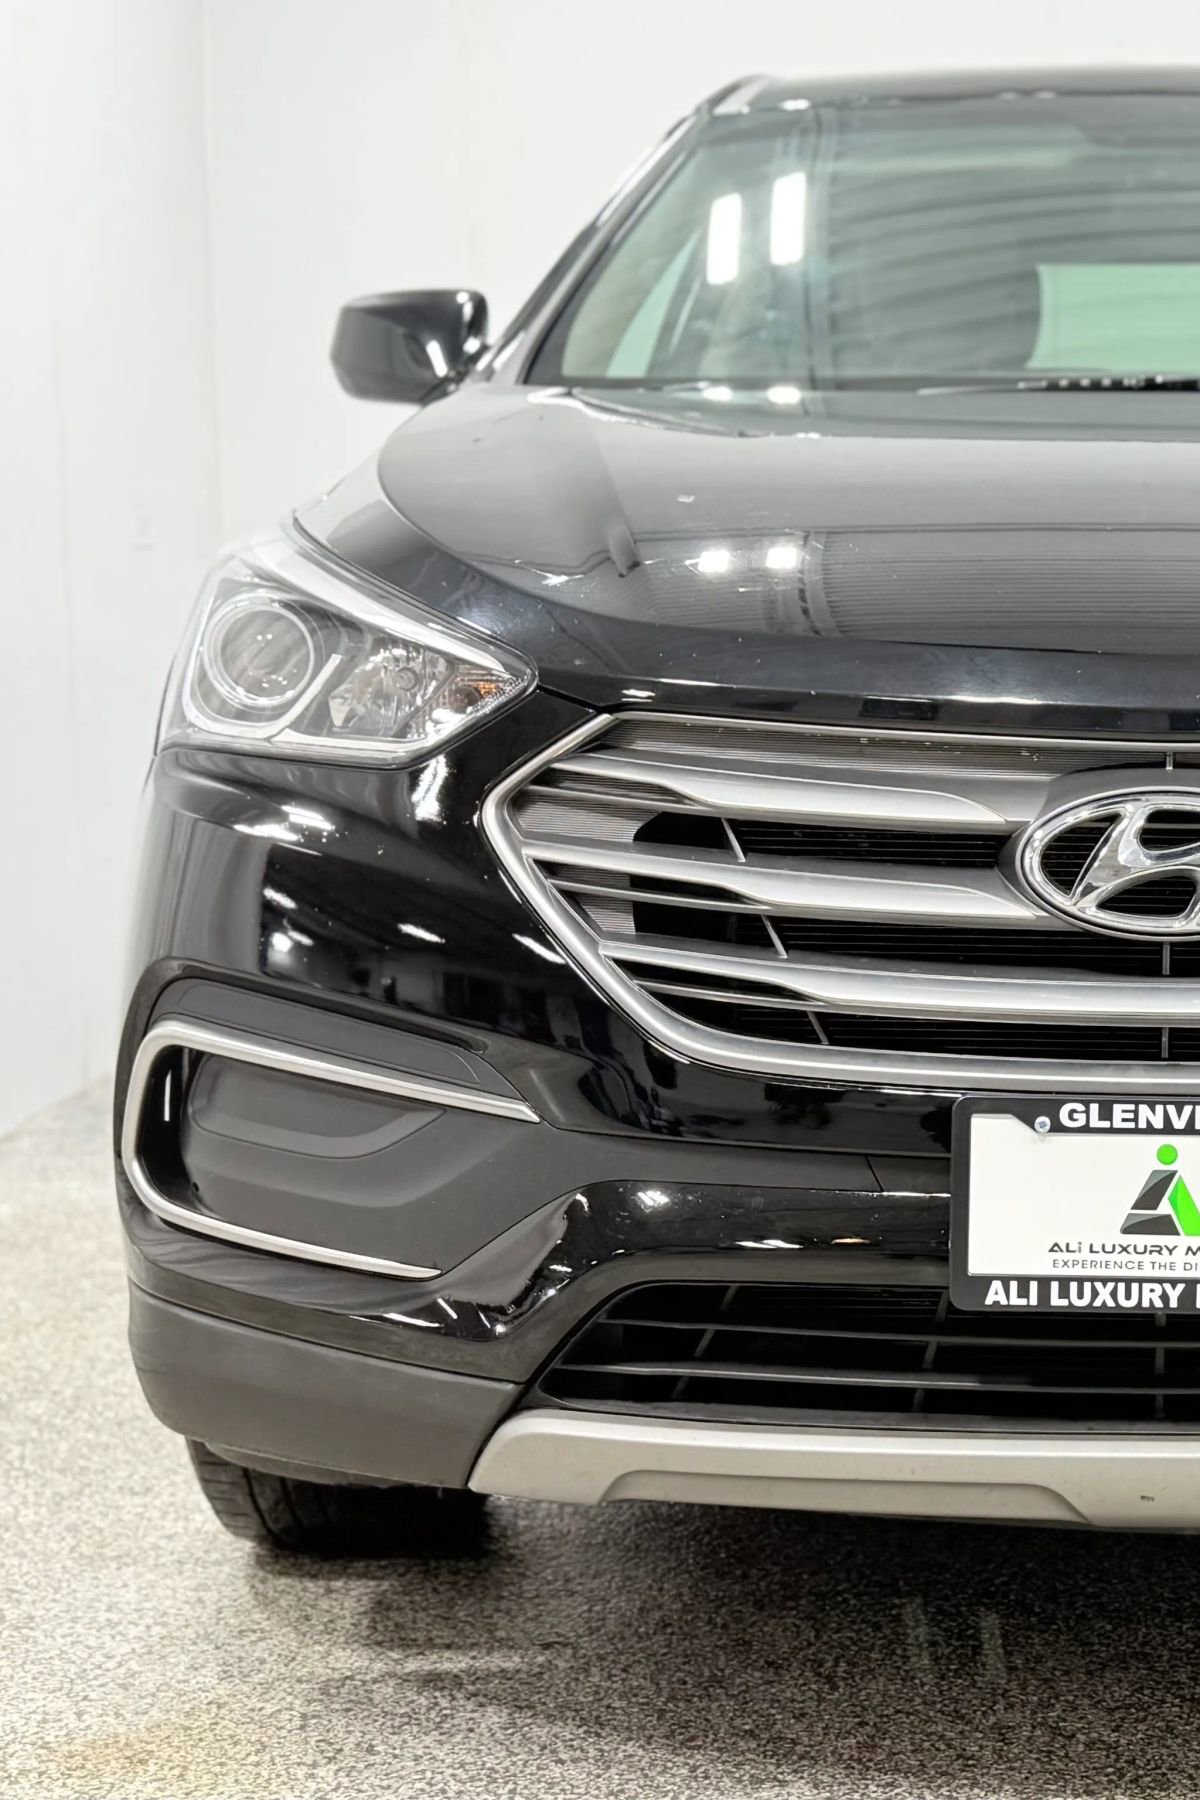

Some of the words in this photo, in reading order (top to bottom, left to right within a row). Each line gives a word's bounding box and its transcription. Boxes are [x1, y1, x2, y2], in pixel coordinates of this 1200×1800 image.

[1089, 1243, 1179, 1257] LUXURY
[1052, 1259, 1144, 1271] EXPERIENCE
[1149, 1261, 1177, 1272] THE
[984, 1280, 1038, 1306] ALI
[1050, 1282, 1185, 1309] LUXURY
